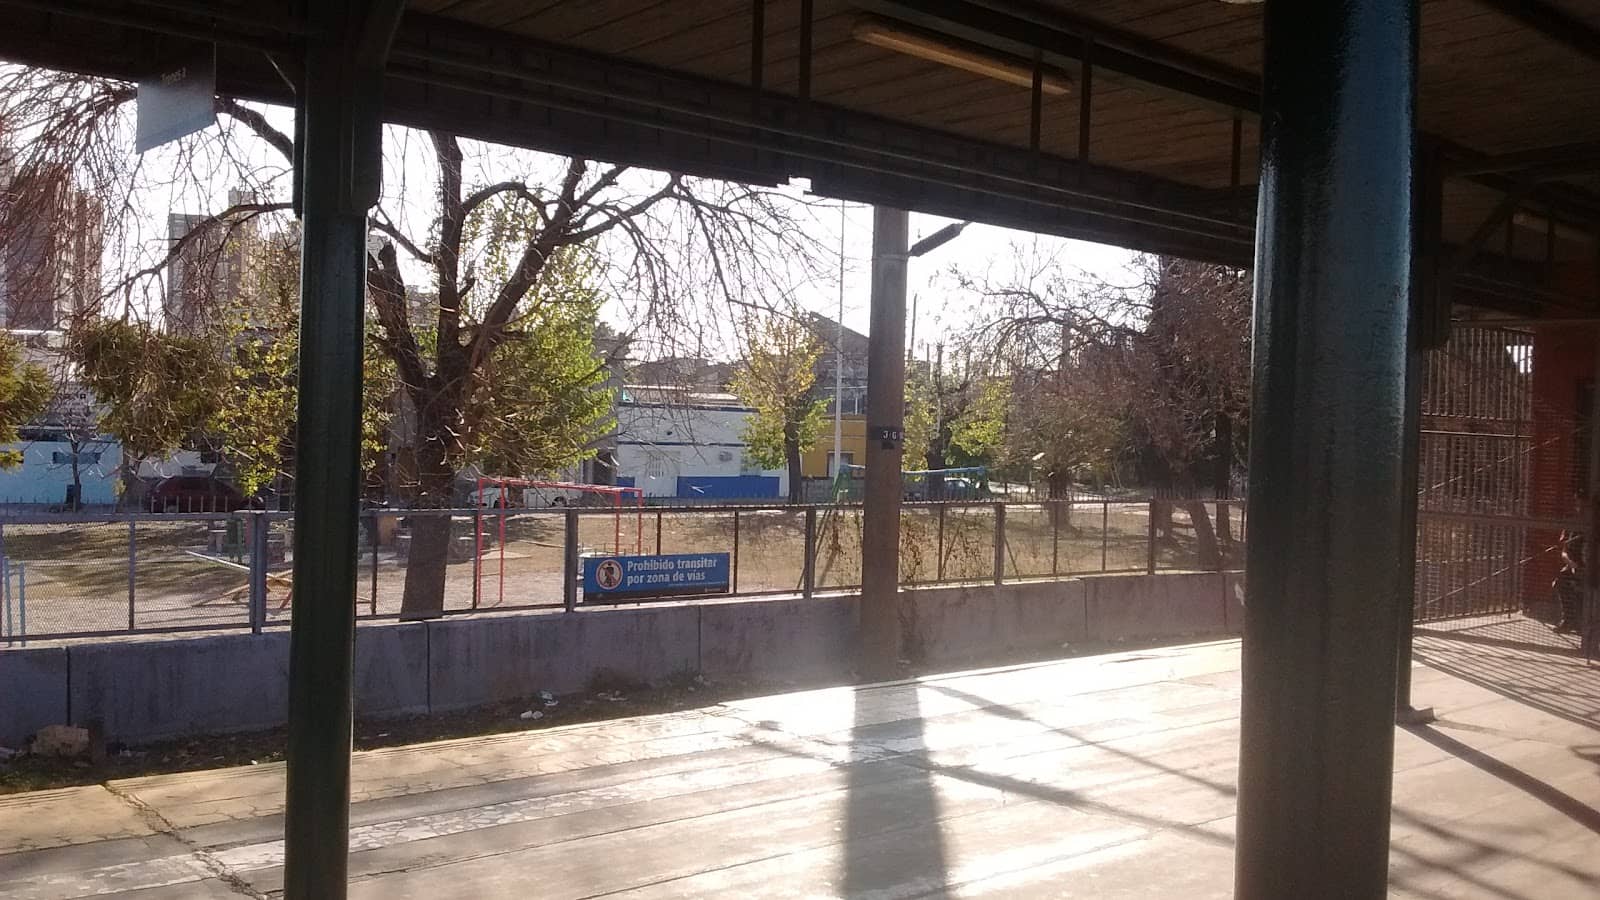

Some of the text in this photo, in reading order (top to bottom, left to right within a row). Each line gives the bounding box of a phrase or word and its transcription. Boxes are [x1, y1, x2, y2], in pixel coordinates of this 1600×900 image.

[627, 557, 717, 571] Prohibido transitar
[627, 569, 705, 586] por zona de vías
